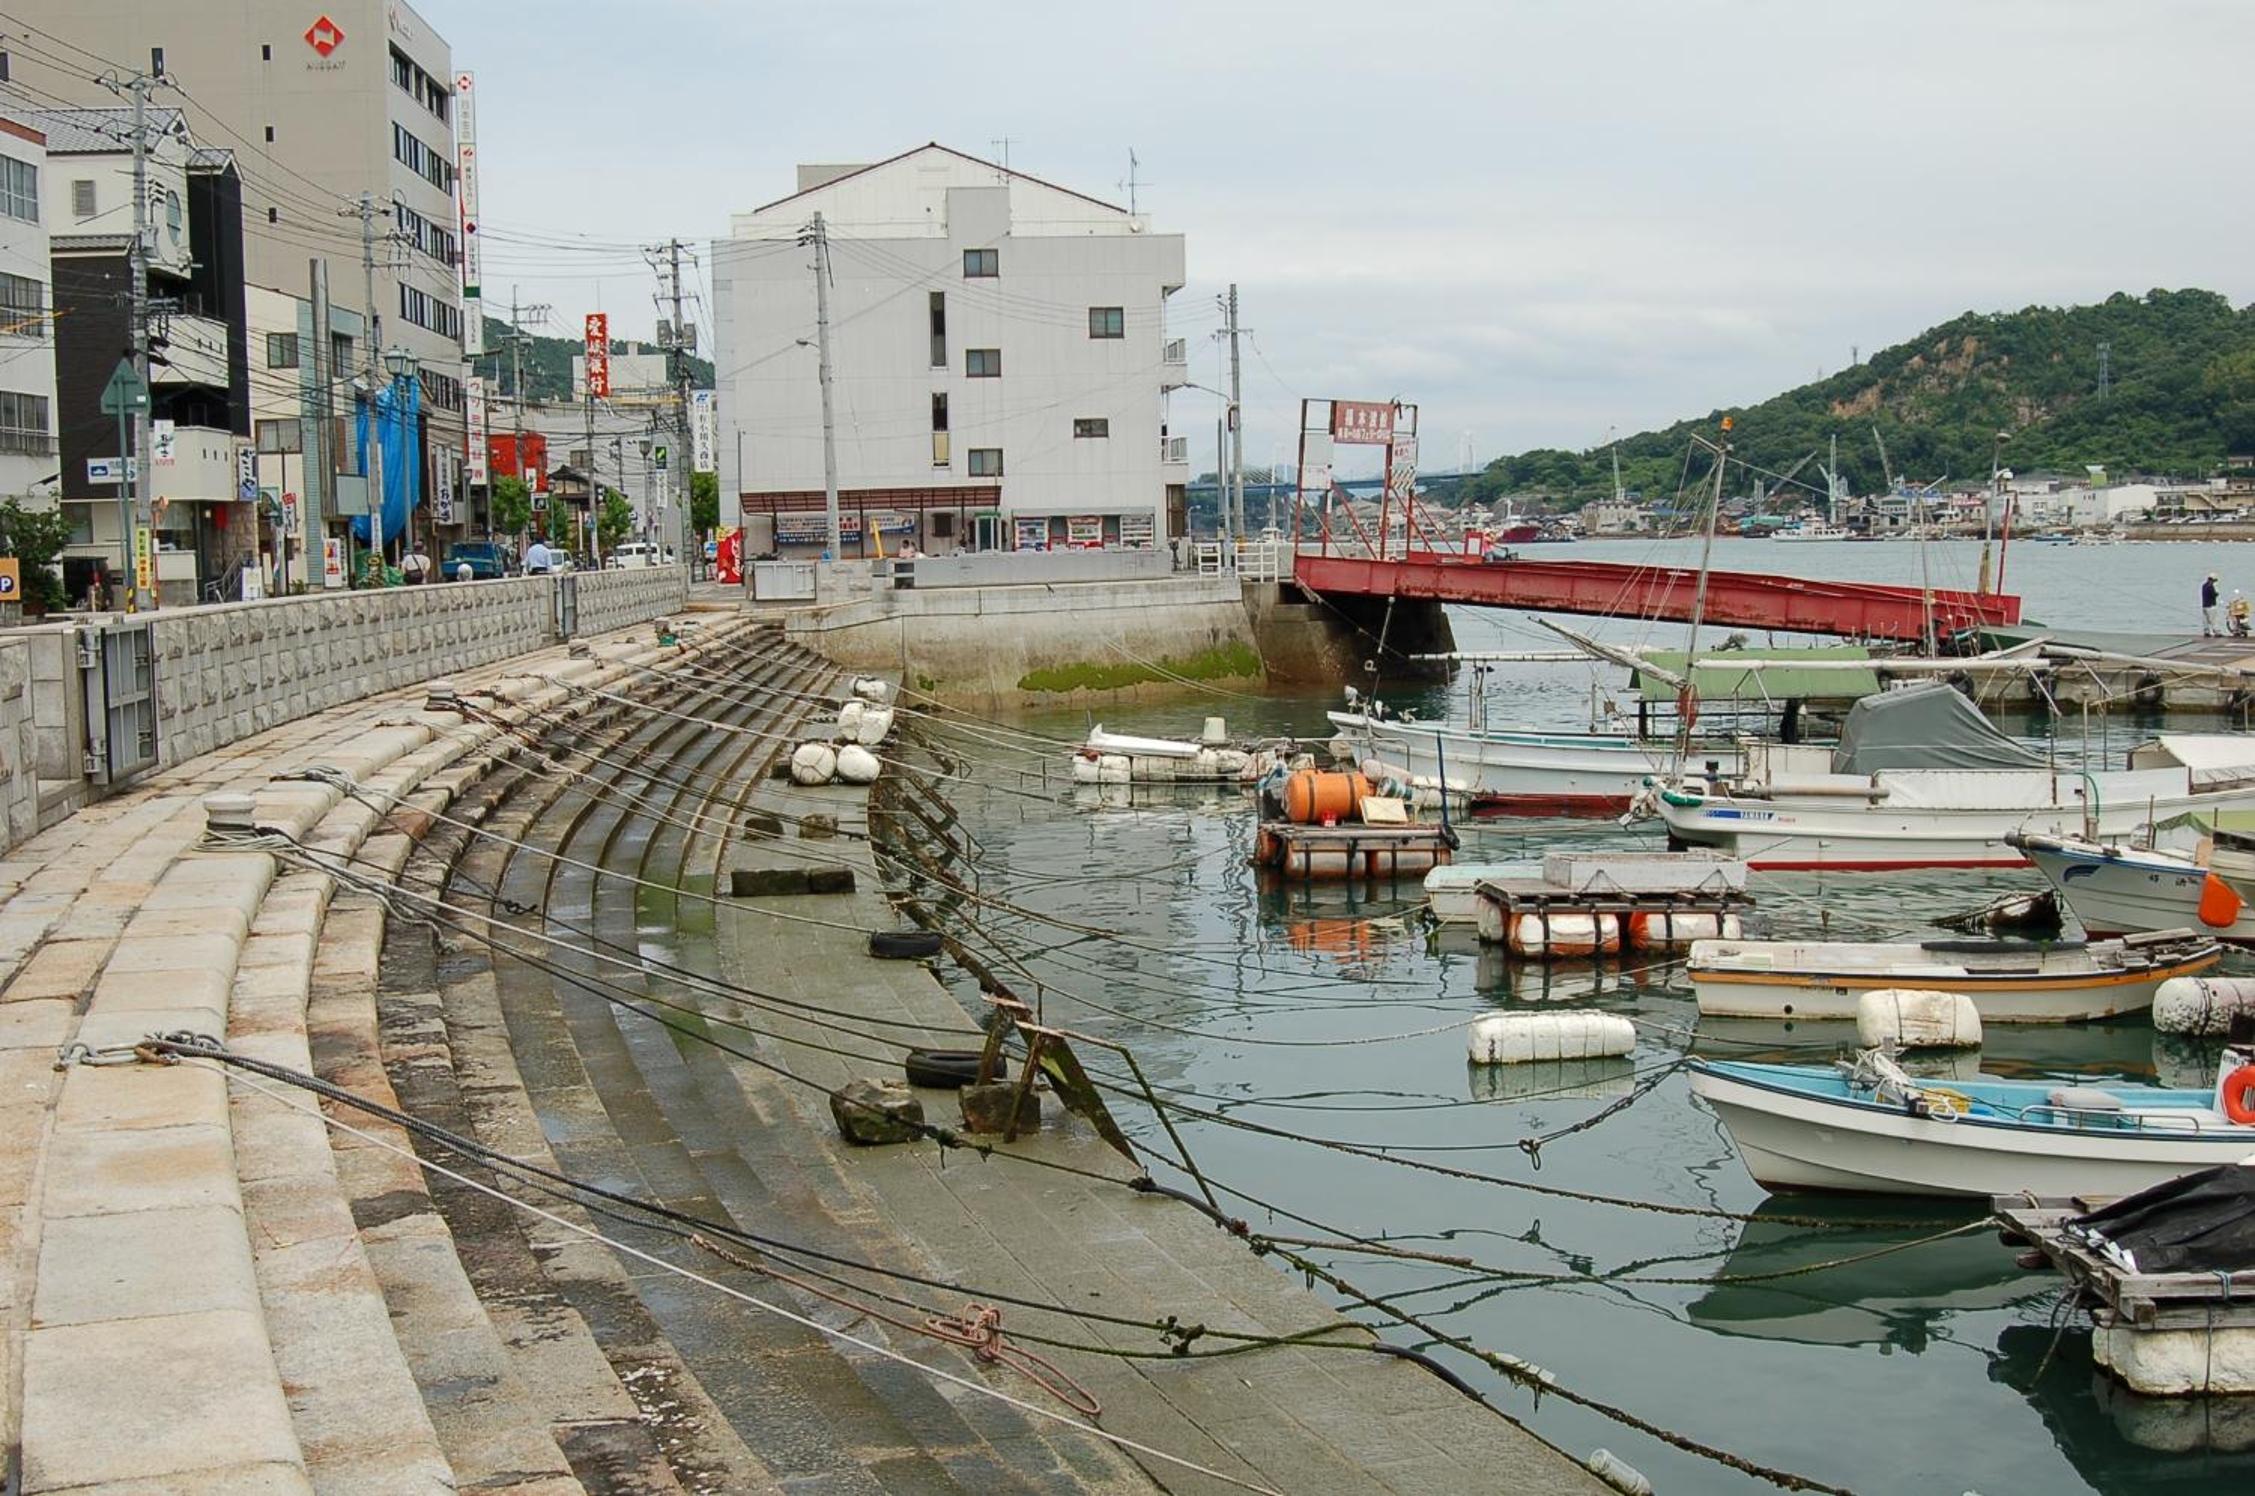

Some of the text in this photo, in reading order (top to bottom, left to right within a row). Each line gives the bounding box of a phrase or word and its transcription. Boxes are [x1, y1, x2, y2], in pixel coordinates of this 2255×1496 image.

[588, 316, 604, 394] 愛媛銀行
[1, 577, 11, 591] P
